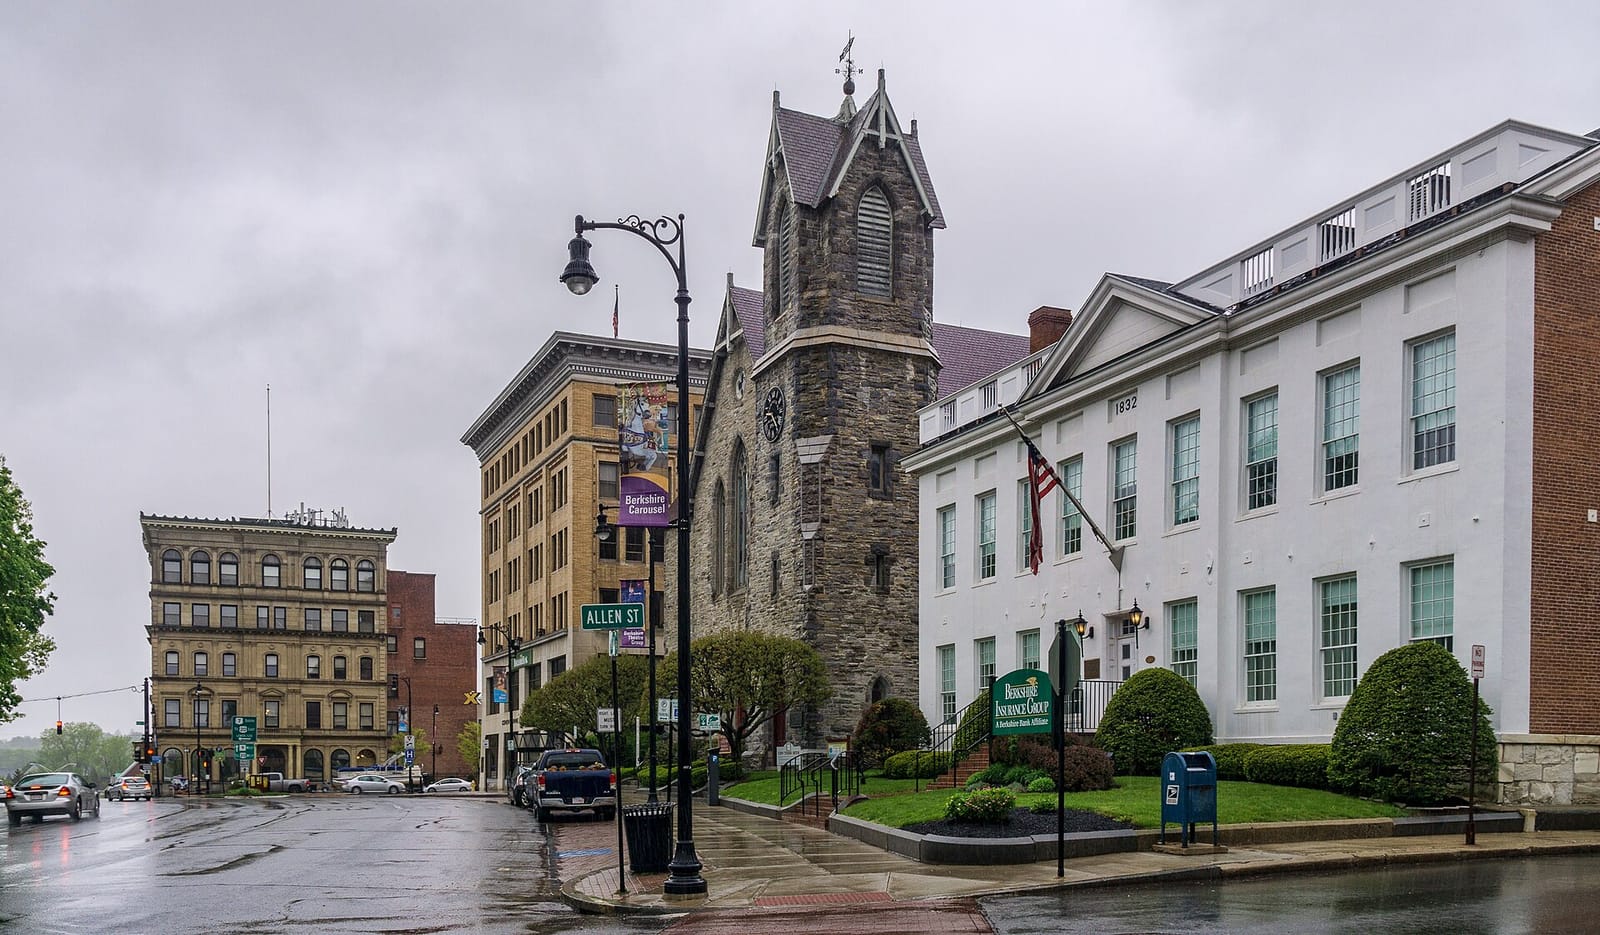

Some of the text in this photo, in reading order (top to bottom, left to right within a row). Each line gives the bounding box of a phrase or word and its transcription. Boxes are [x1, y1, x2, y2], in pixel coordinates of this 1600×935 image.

[1115, 396, 1137, 415] 1832
[625, 494, 665, 505] Berkshire
[628, 503, 666, 514] Carousel
[586, 608, 639, 625] ALLEN ST
[1000, 720, 1019, 728] Berkshire
[406, 750, 413, 758] H
